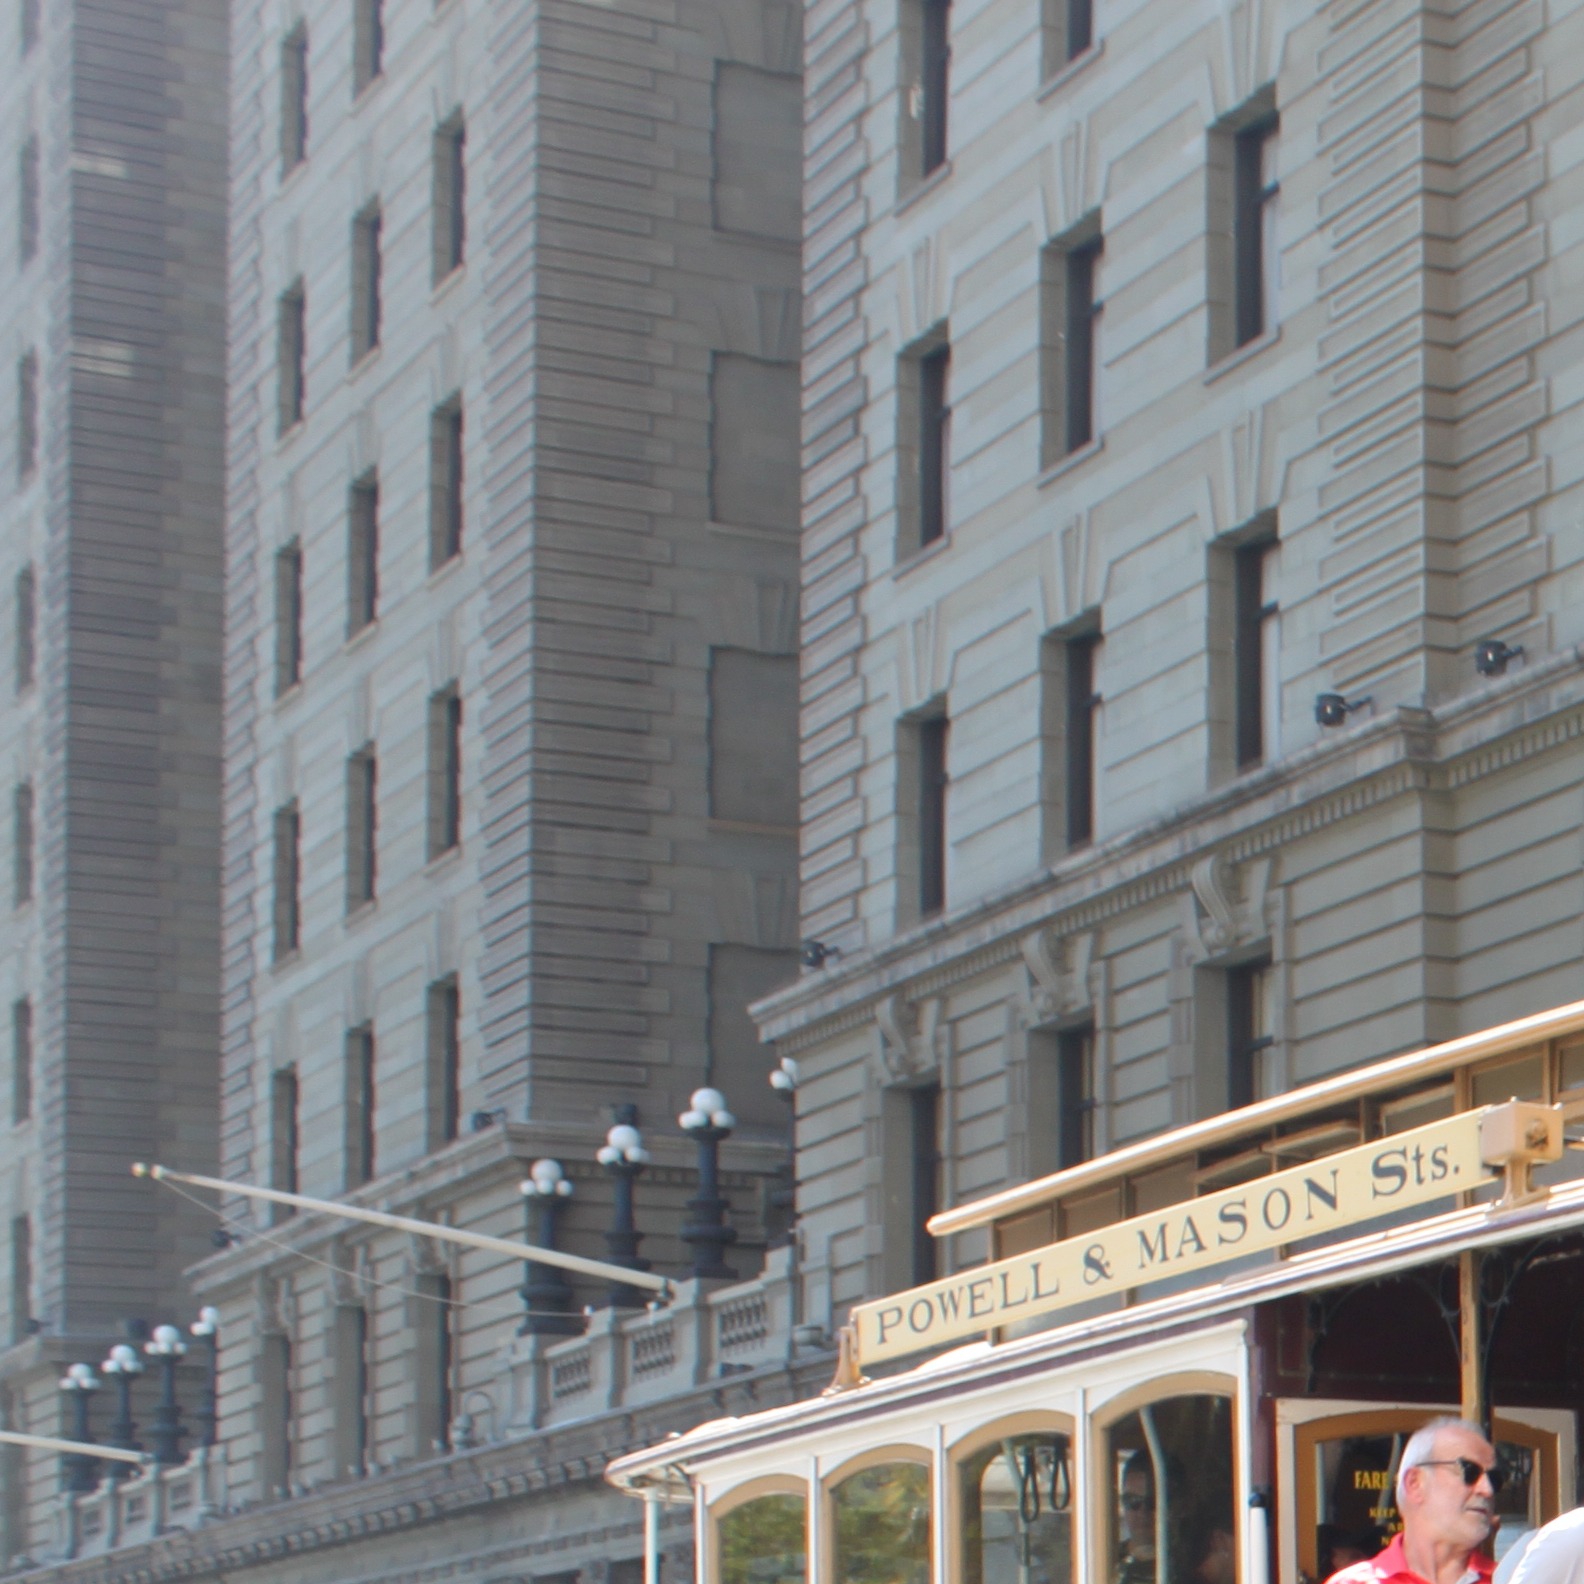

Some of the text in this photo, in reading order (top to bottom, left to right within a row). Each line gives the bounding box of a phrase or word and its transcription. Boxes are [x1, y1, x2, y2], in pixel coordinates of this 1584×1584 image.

[877, 1141, 1462, 1346] POWELL & MASON Sts.
[1353, 1470, 1390, 1490] FARE
